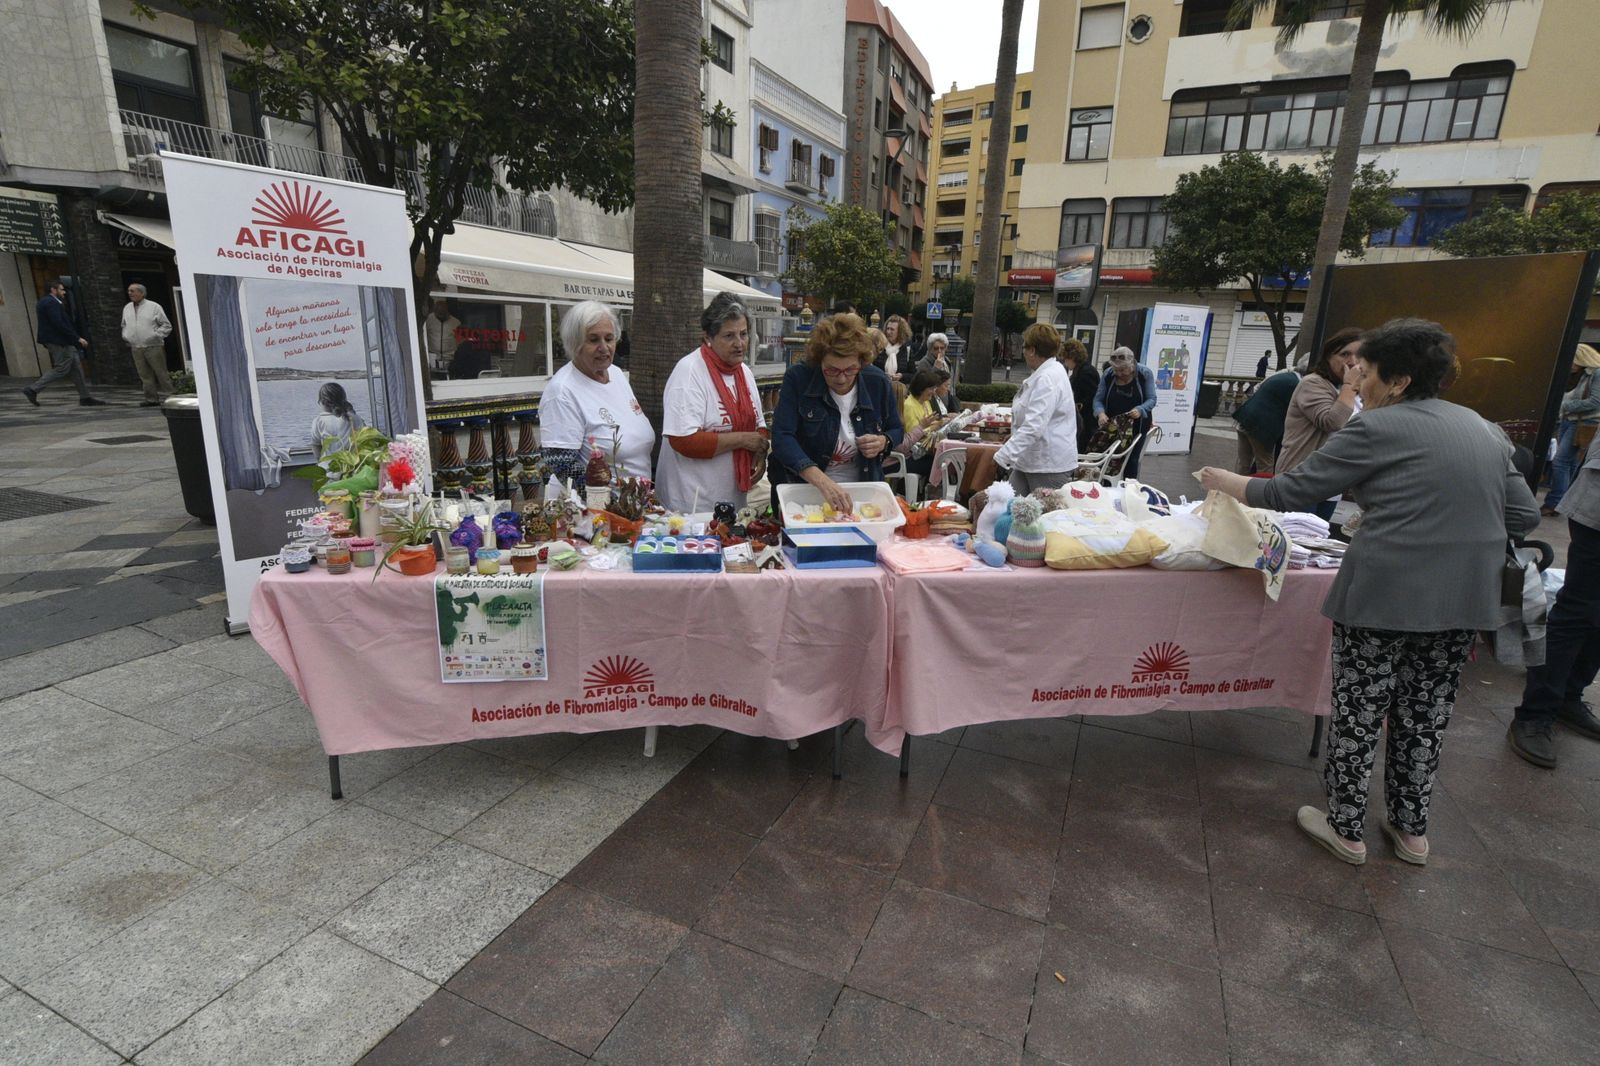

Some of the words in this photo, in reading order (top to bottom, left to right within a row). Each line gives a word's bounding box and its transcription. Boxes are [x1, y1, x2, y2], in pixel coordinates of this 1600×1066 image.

[853, 38, 869, 142] EDIFICIO
[235, 226, 365, 258] AFICAGI
[217, 248, 289, 263] Asociación
[293, 255, 308, 265] de
[311, 256, 382, 272] Fibromialgia
[267, 264, 282, 274] de
[287, 265, 342, 279] Algeciras
[452, 273, 490, 286] VICTORIA
[564, 283, 581, 294] BAR
[581, 286, 593, 295] DE
[593, 286, 615, 297] TAPAS
[616, 289, 626, 299] LA
[265, 305, 300, 318] Algunas
[302, 299, 340, 311] mañanas
[255, 322, 272, 334] solo
[275, 321, 297, 331] tengo
[299, 315, 309, 325] la
[265, 337, 276, 347] de
[278, 332, 318, 345] encontrar
[320, 329, 332, 337] un
[334, 324, 356, 335] lugar
[284, 348, 304, 360] para
[305, 339, 346, 352] descansar
[285, 505, 326, 517] FEDERAC
[1131, 672, 1189, 684] AFICAGI
[584, 684, 655, 699] AFICAGI
[1031, 685, 1091, 702] Asociación
[1094, 685, 1107, 698] de
[1110, 682, 1171, 699] Fibromialgia
[1180, 681, 1214, 696] Campo
[1217, 680, 1230, 693] de
[1233, 678, 1275, 693] Gibraltar
[471, 702, 542, 723] Asociación
[545, 700, 560, 715] de
[564, 695, 638, 715] Fibromialgia
[648, 693, 688, 709] Campo
[691, 693, 706, 707] de
[709, 694, 758, 718] Gibraltar
